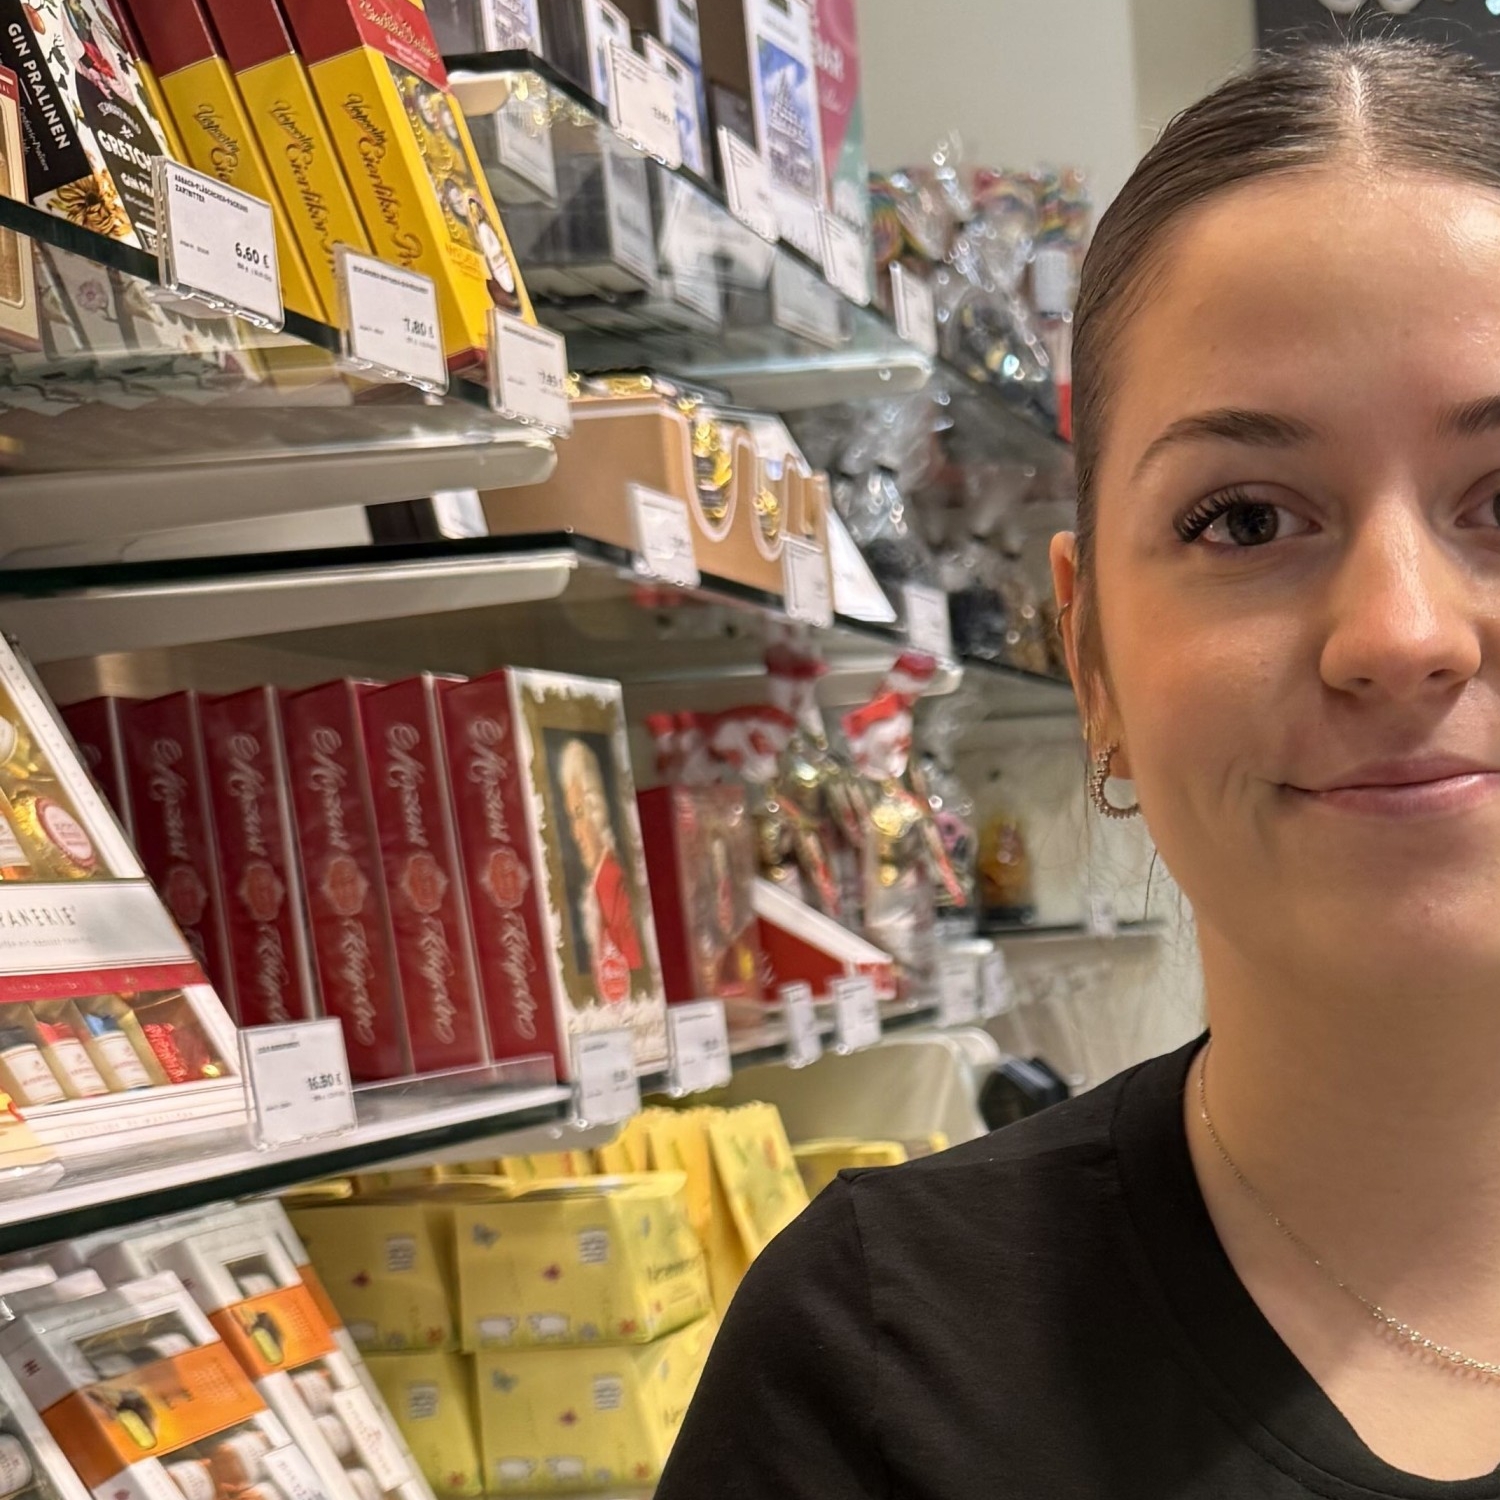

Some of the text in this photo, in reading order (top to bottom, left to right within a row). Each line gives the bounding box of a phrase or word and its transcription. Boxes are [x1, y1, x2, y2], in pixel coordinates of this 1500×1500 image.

[8, 23, 71, 149] GIN PRALINEN
[235, 242, 260, 265] 6.60
